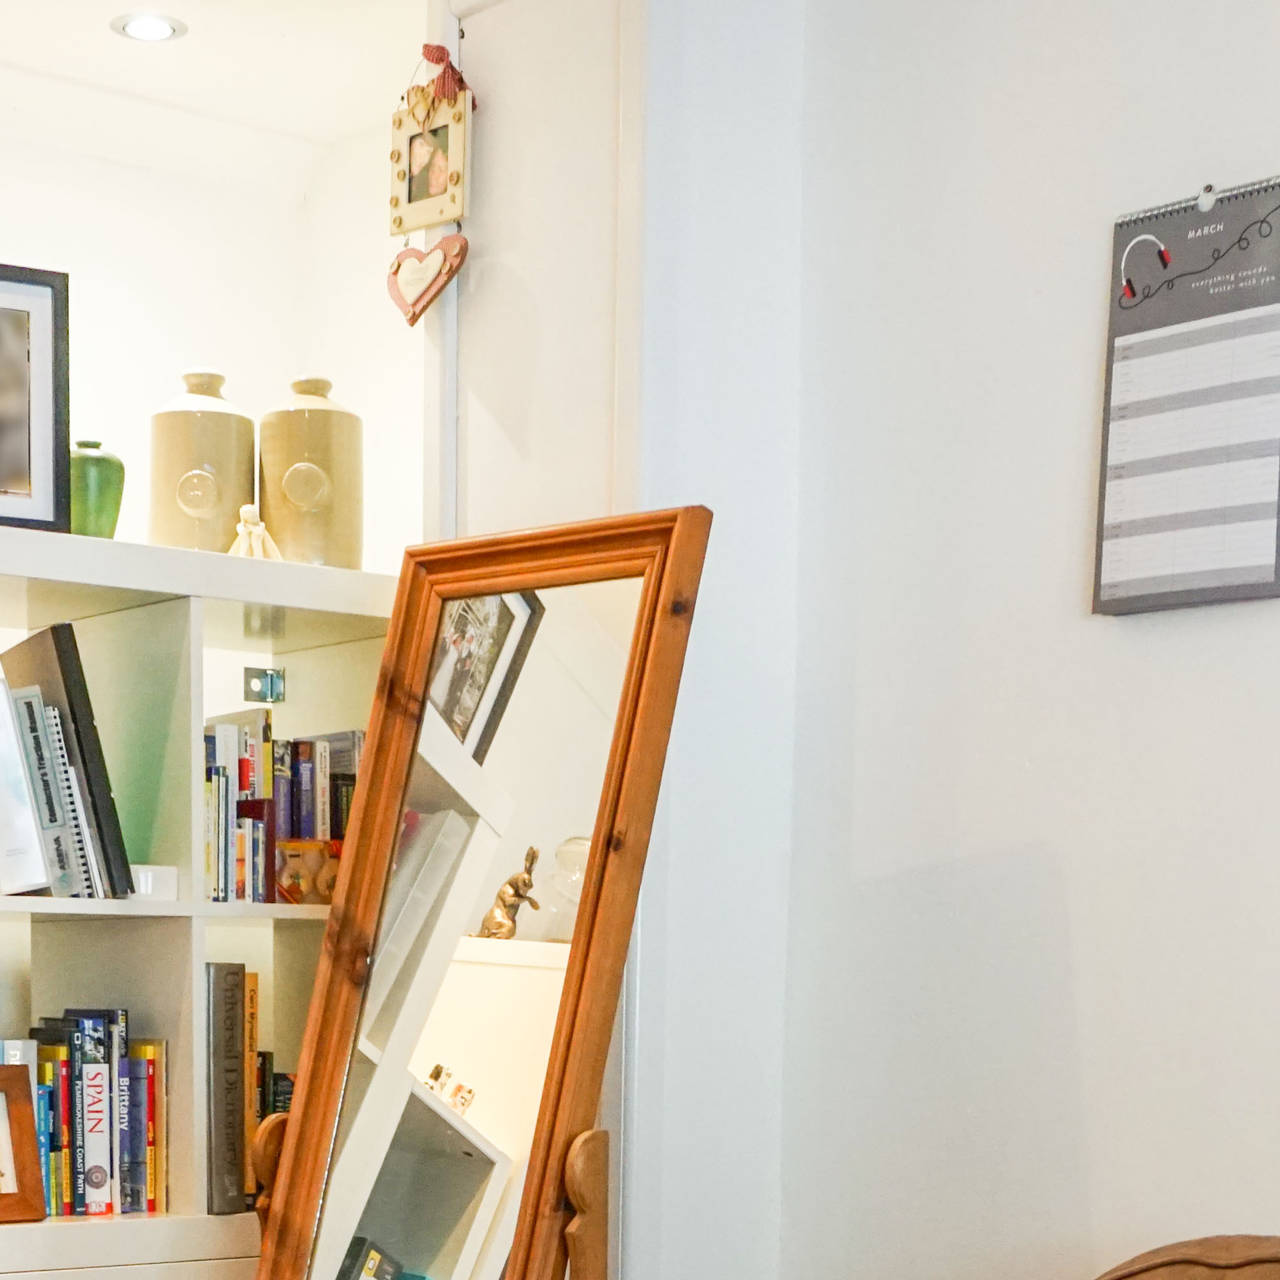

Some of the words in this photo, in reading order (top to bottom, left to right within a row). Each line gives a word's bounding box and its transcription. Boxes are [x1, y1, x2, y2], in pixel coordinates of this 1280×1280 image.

[1187, 222, 1224, 239] MARCH
[31, 735, 46, 771] Traction
[40, 772, 58, 823] Conductor's
[224, 971, 239, 1060] Universal
[74, 1080, 84, 1147] PEMBROKESHIRE
[87, 1072, 104, 1134] SPAIN
[119, 1077, 130, 1131] Brittany
[224, 1068, 239, 1165] Dictionary
[76, 1148, 85, 1172] COAST
[77, 1173, 85, 1194] PATH
